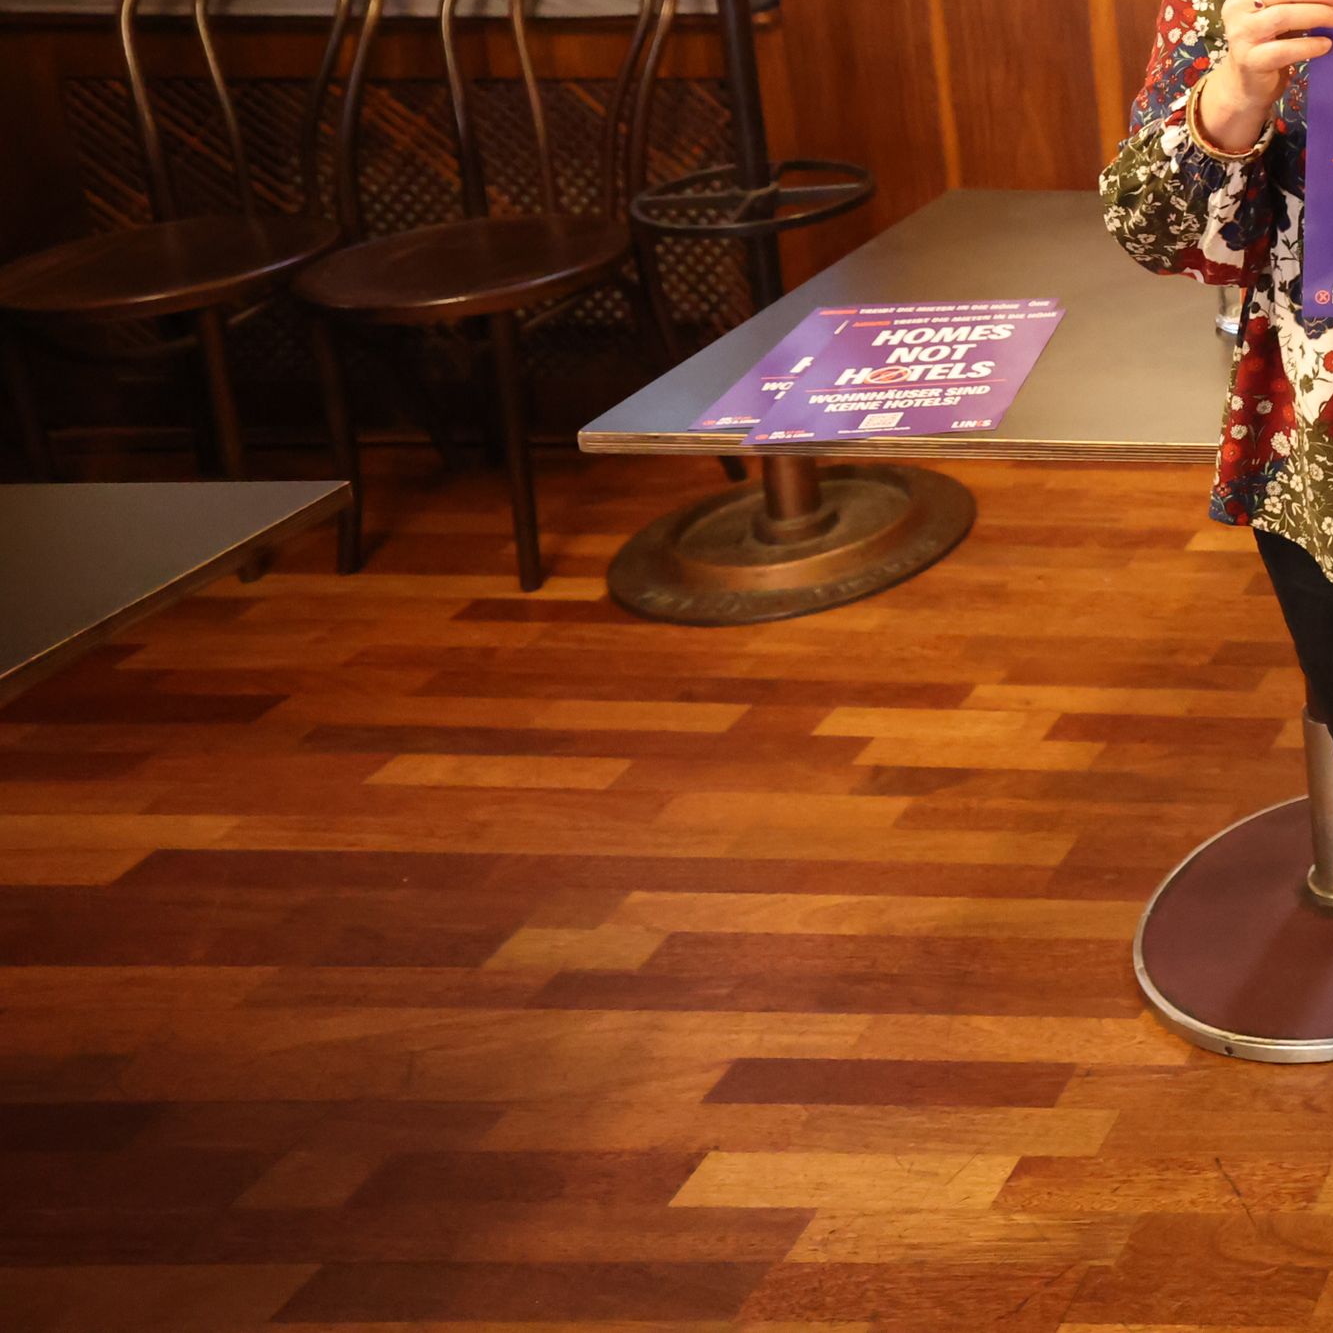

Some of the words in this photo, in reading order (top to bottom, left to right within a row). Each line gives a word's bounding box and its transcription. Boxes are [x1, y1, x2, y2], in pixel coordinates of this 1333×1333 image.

[871, 323, 1015, 346] HOMES
[885, 343, 977, 364] NOT
[809, 388, 942, 404] WOHNHÄUSER
[945, 385, 990, 396] SIND
[824, 400, 882, 413] KEINE
[883, 396, 961, 409] HOTELS!
